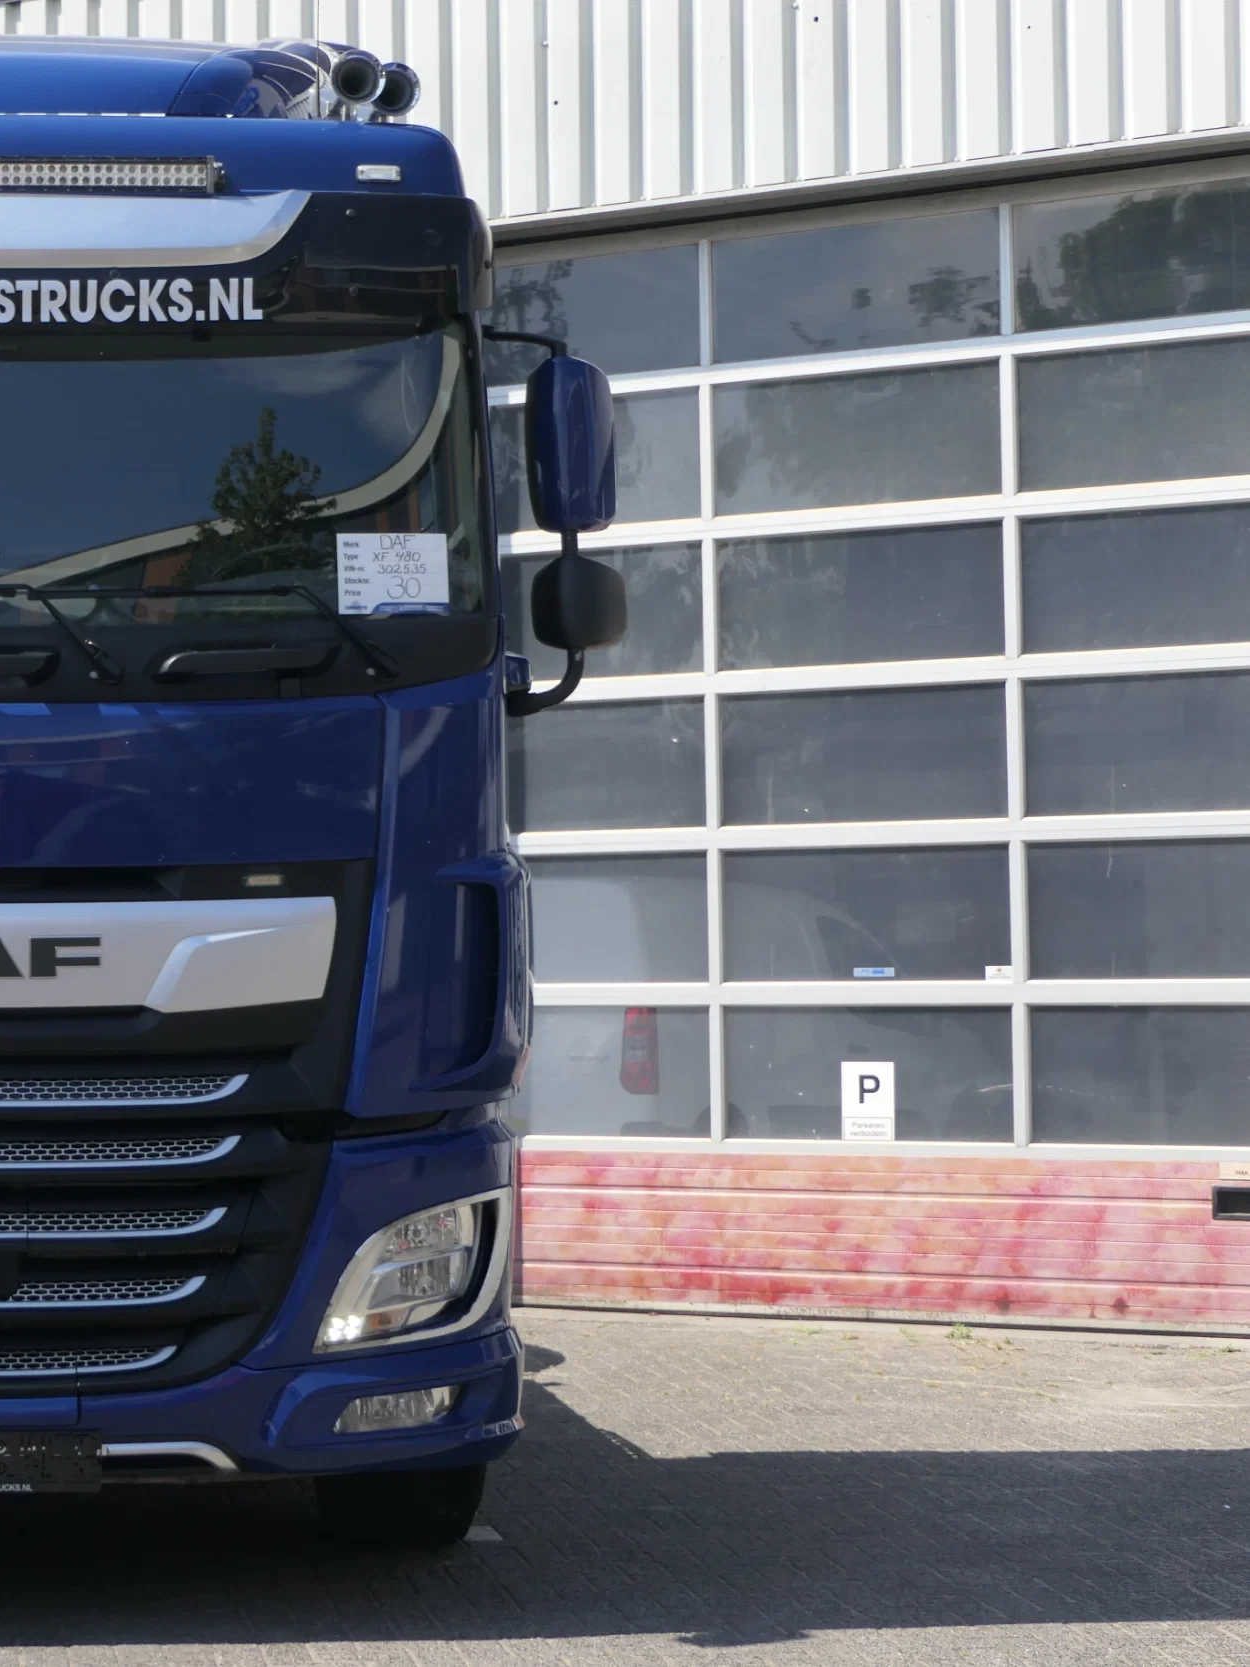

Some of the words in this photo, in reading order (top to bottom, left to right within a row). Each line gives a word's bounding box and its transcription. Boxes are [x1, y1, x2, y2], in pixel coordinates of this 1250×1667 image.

[379, 534, 416, 550] DAF
[344, 553, 359, 561] Type
[372, 551, 390, 563] XF
[395, 551, 421, 562] 480
[377, 563, 427, 574] 302535
[344, 589, 361, 597] Price
[386, 575, 421, 599] 30
[858, 1074, 880, 1104] P
